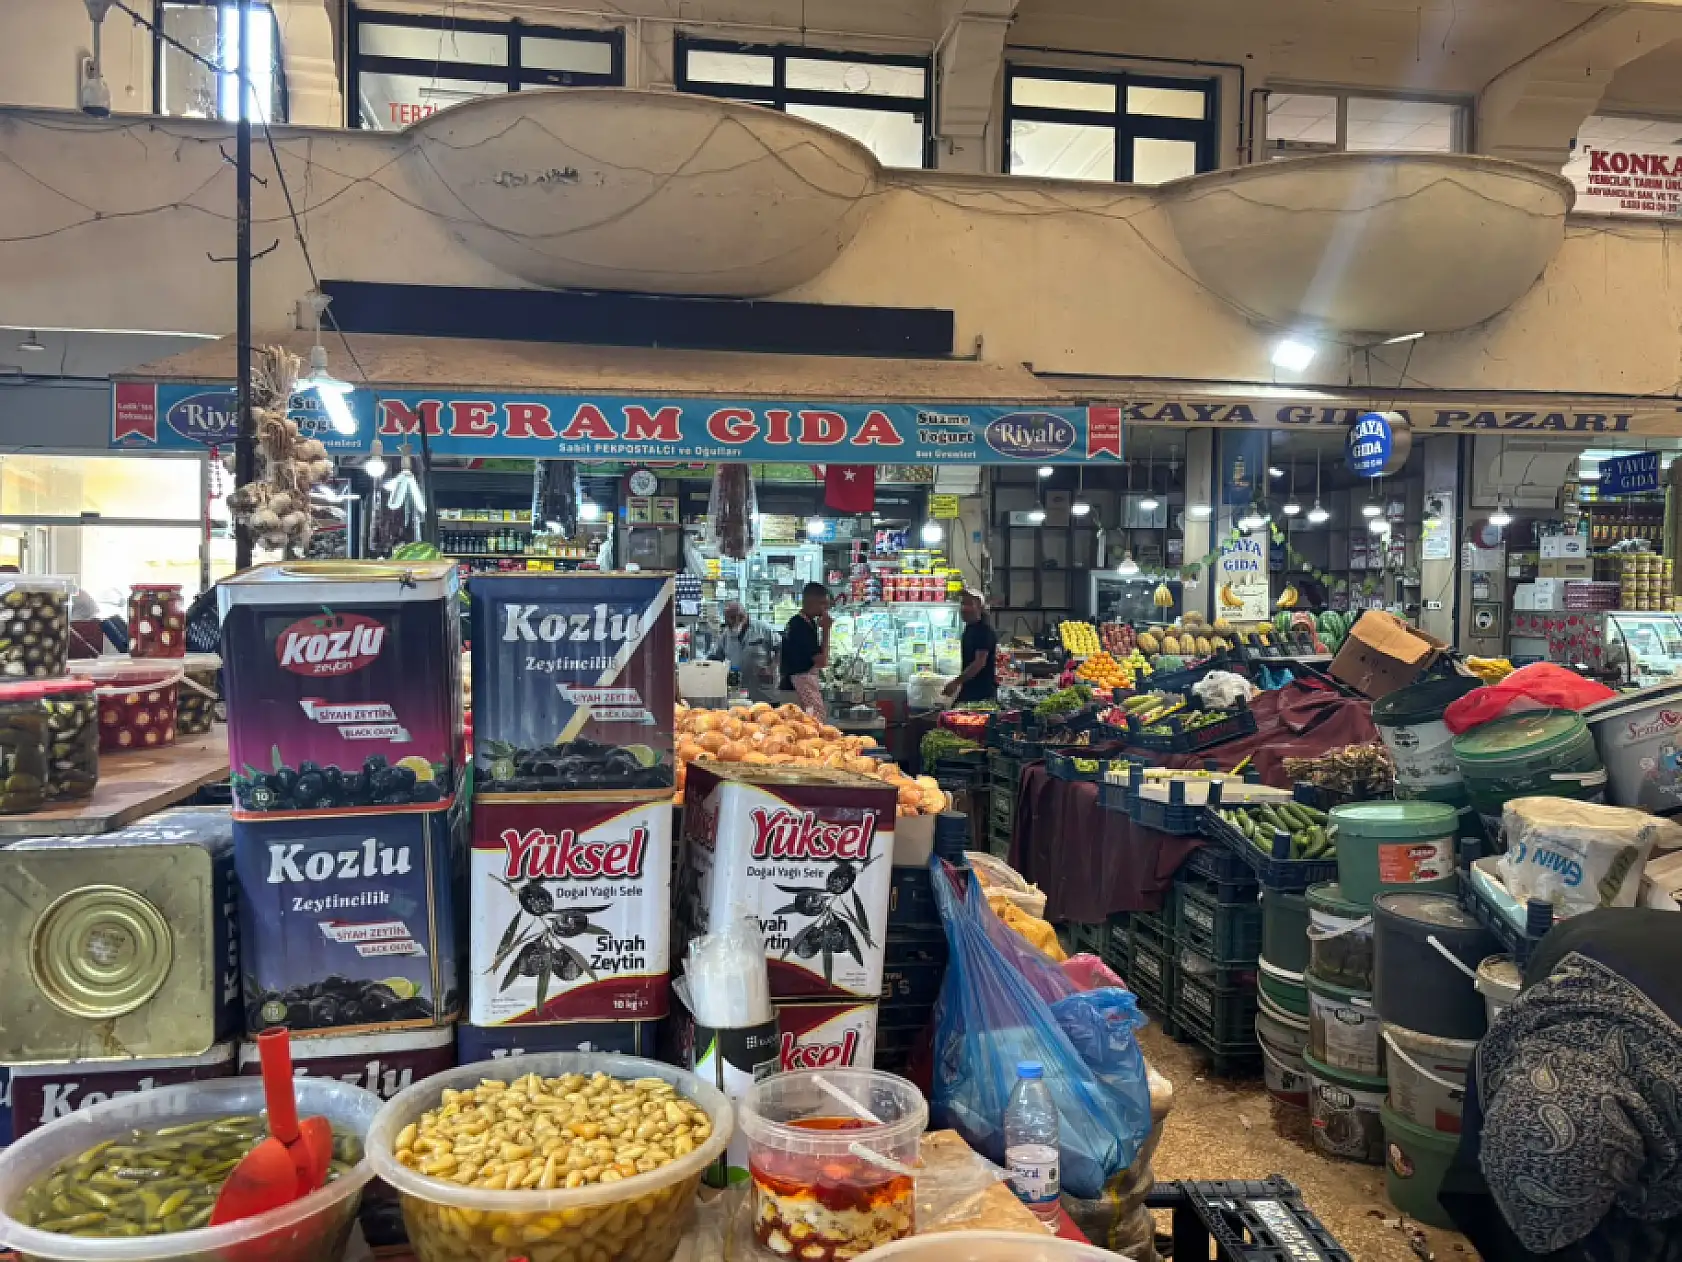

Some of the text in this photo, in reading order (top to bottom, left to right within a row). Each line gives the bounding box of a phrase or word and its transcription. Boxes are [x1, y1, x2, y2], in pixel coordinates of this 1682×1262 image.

[378, 398, 683, 442] MERAM
[1124, 402, 1259, 423] KAYA
[1430, 409, 1632, 432] PAZARI
[706, 406, 905, 446] GIDA
[995, 423, 1067, 447] Riyale
[679, 447, 692, 456] ve
[1352, 440, 1382, 458] GIDA
[1617, 455, 1657, 475] YAVUZ
[1621, 473, 1655, 488] GIDA
[1223, 559, 1259, 572] GIDA
[502, 603, 638, 641] Kozlu
[313, 661, 353, 673] zeytin
[525, 657, 618, 673] Zeytincilik
[749, 807, 877, 861] Yüksel
[267, 837, 412, 884] Kozlu
[500, 825, 648, 881] Yüksel
[747, 866, 825, 880] Doğal Yağlı Sele
[292, 890, 391, 912] Zeytincilik
[556, 885, 643, 900] Doğal Yağlı Sele
[596, 934, 646, 955] Siyah
[590, 953, 645, 973] Zeytin
[613, 999, 637, 1011] 10 kg
